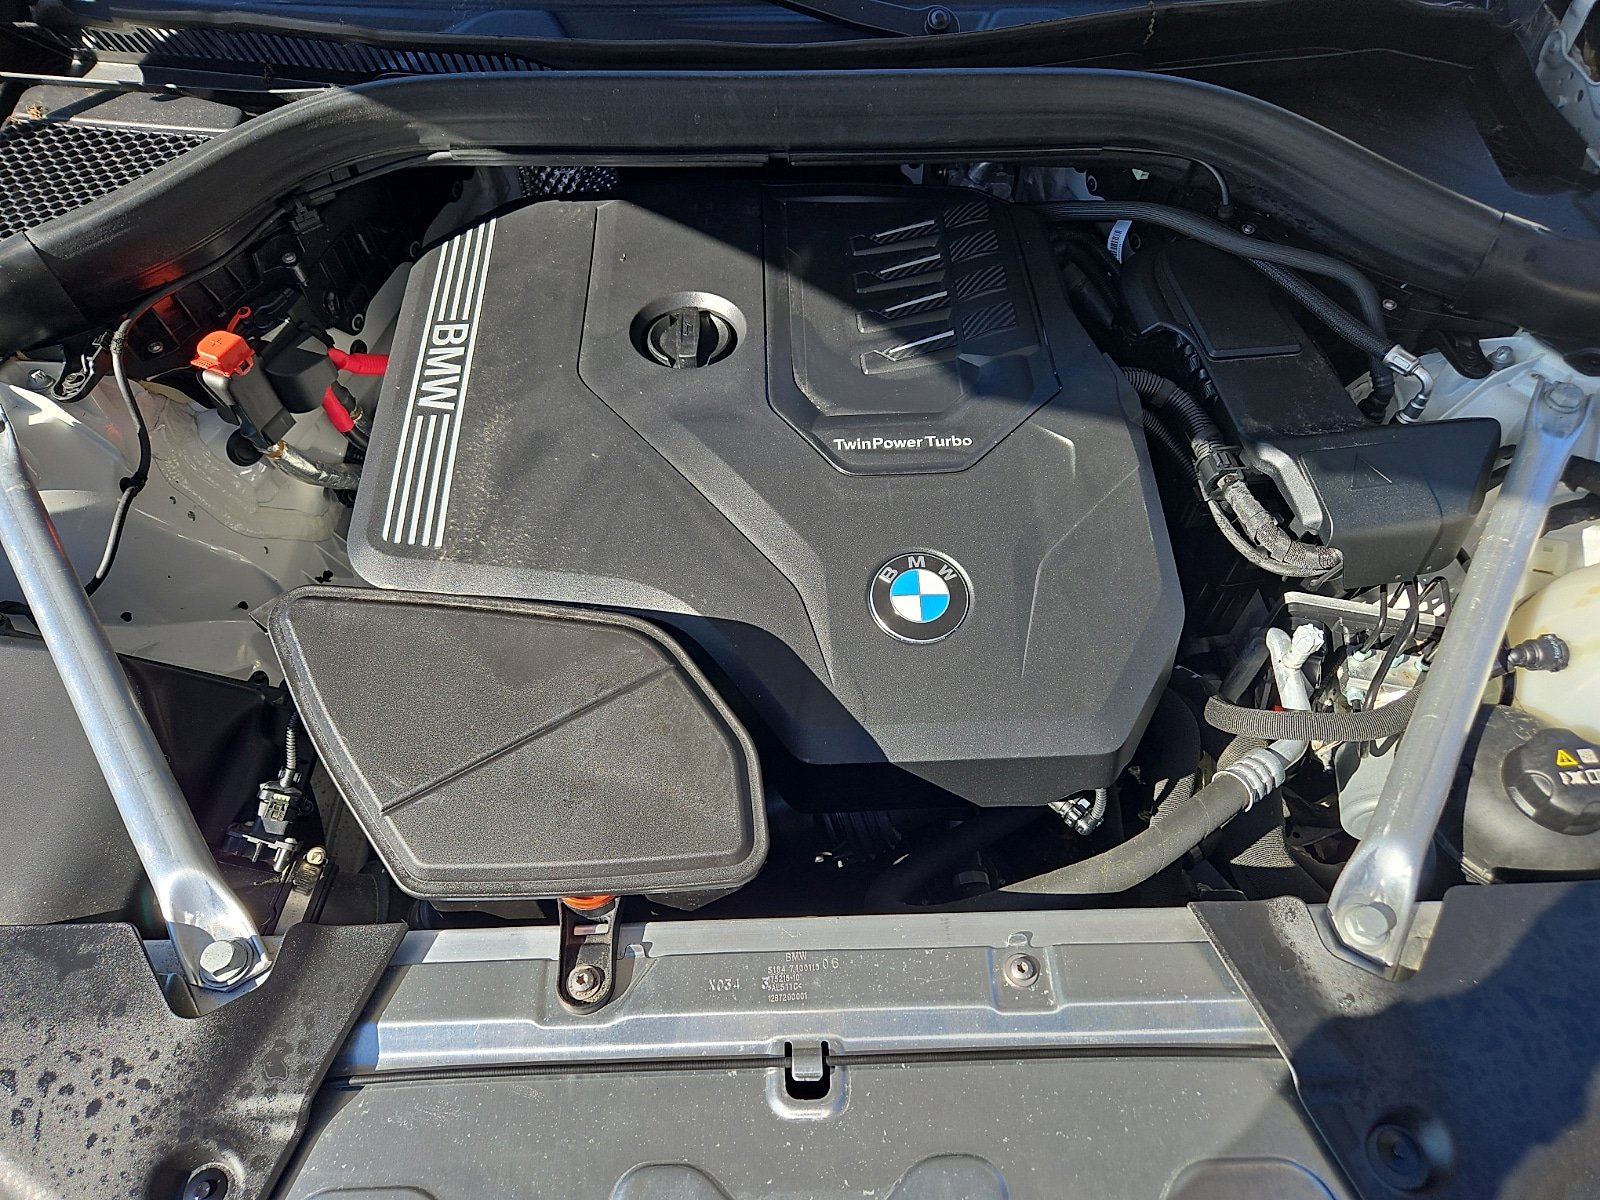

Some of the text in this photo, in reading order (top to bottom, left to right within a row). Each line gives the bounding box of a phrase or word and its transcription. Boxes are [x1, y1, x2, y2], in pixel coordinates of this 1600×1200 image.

[417, 323, 470, 410] BMW
[832, 434, 973, 451] TwinPower Turbo
[878, 555, 958, 584] BMW
[785, 951, 808, 962] BMW
